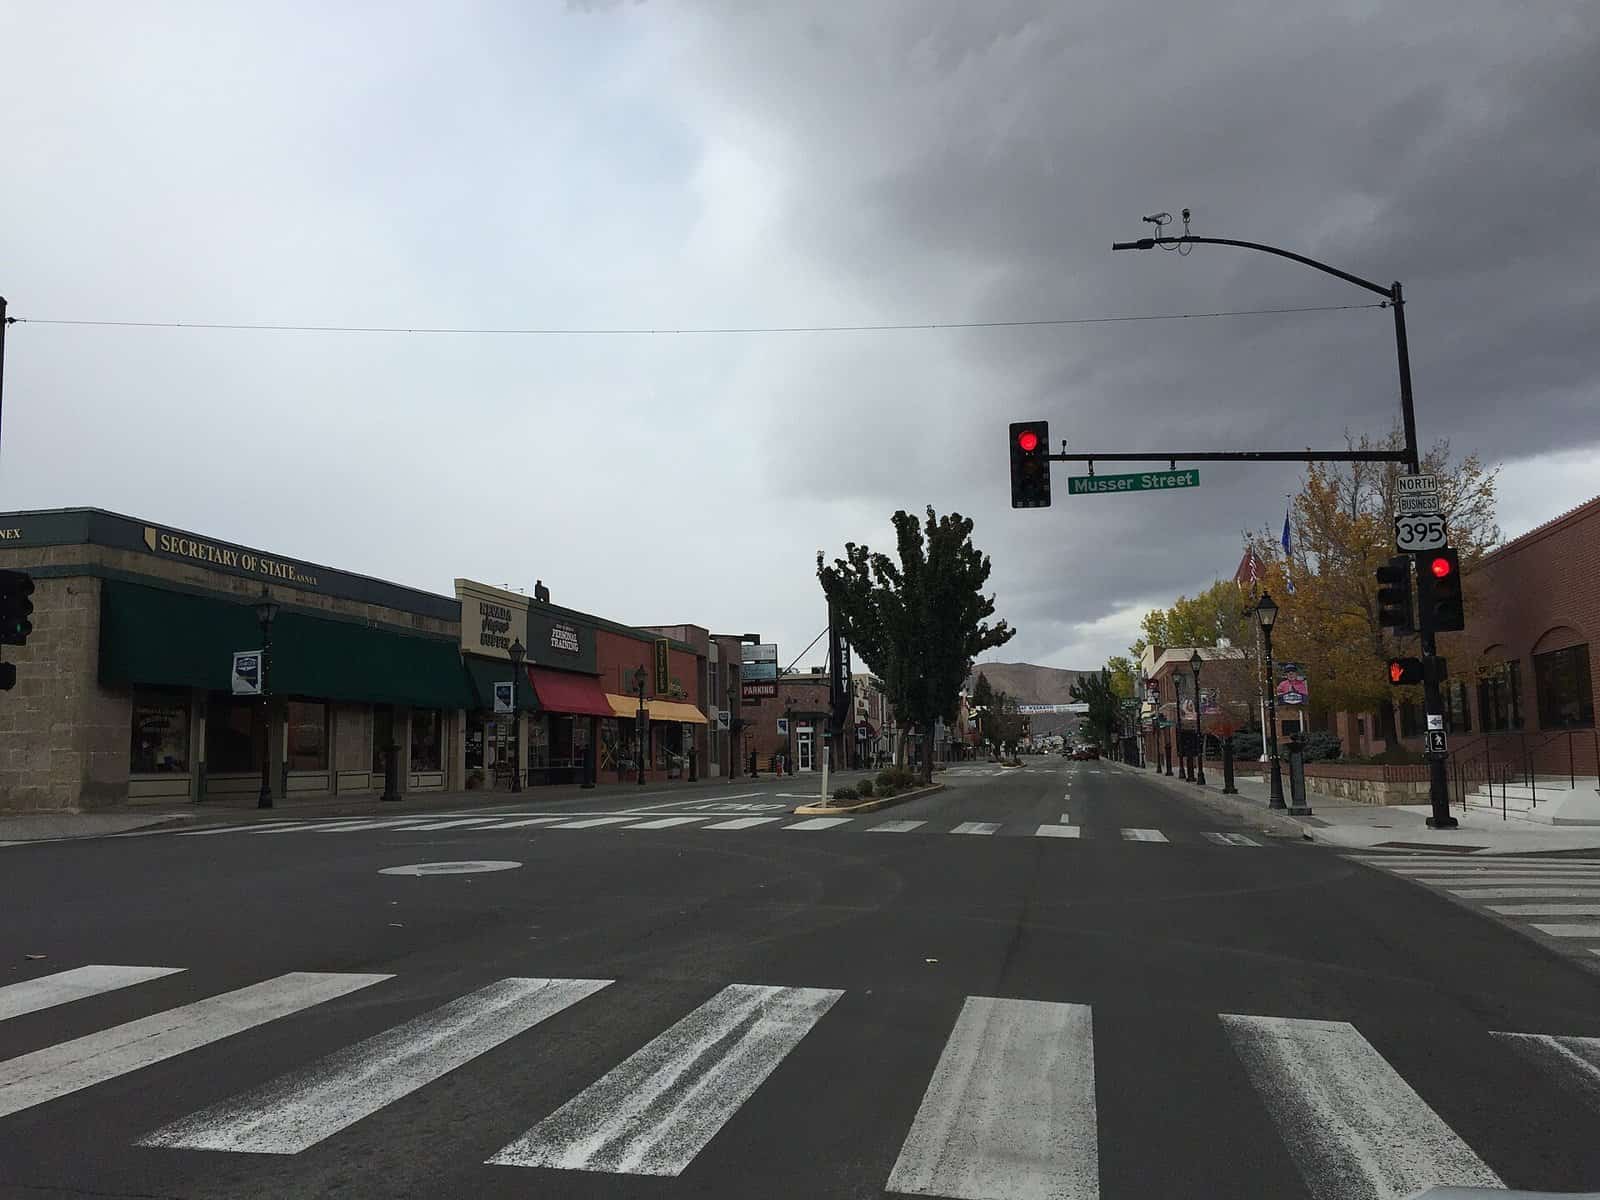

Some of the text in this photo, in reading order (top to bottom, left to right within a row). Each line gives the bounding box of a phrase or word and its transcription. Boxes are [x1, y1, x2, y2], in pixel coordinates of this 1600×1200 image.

[1074, 472, 1193, 492] Musser Street
[1400, 478, 1435, 490] NORTH
[1401, 498, 1437, 510] BUSINESS
[1400, 522, 1443, 543] 395
[160, 534, 239, 567] SECRETARY
[241, 554, 257, 571] OF
[260, 558, 296, 580] STATE
[552, 628, 577, 643] PERSONAL
[550, 638, 579, 652] TRAINING
[743, 686, 774, 696] PARKING
